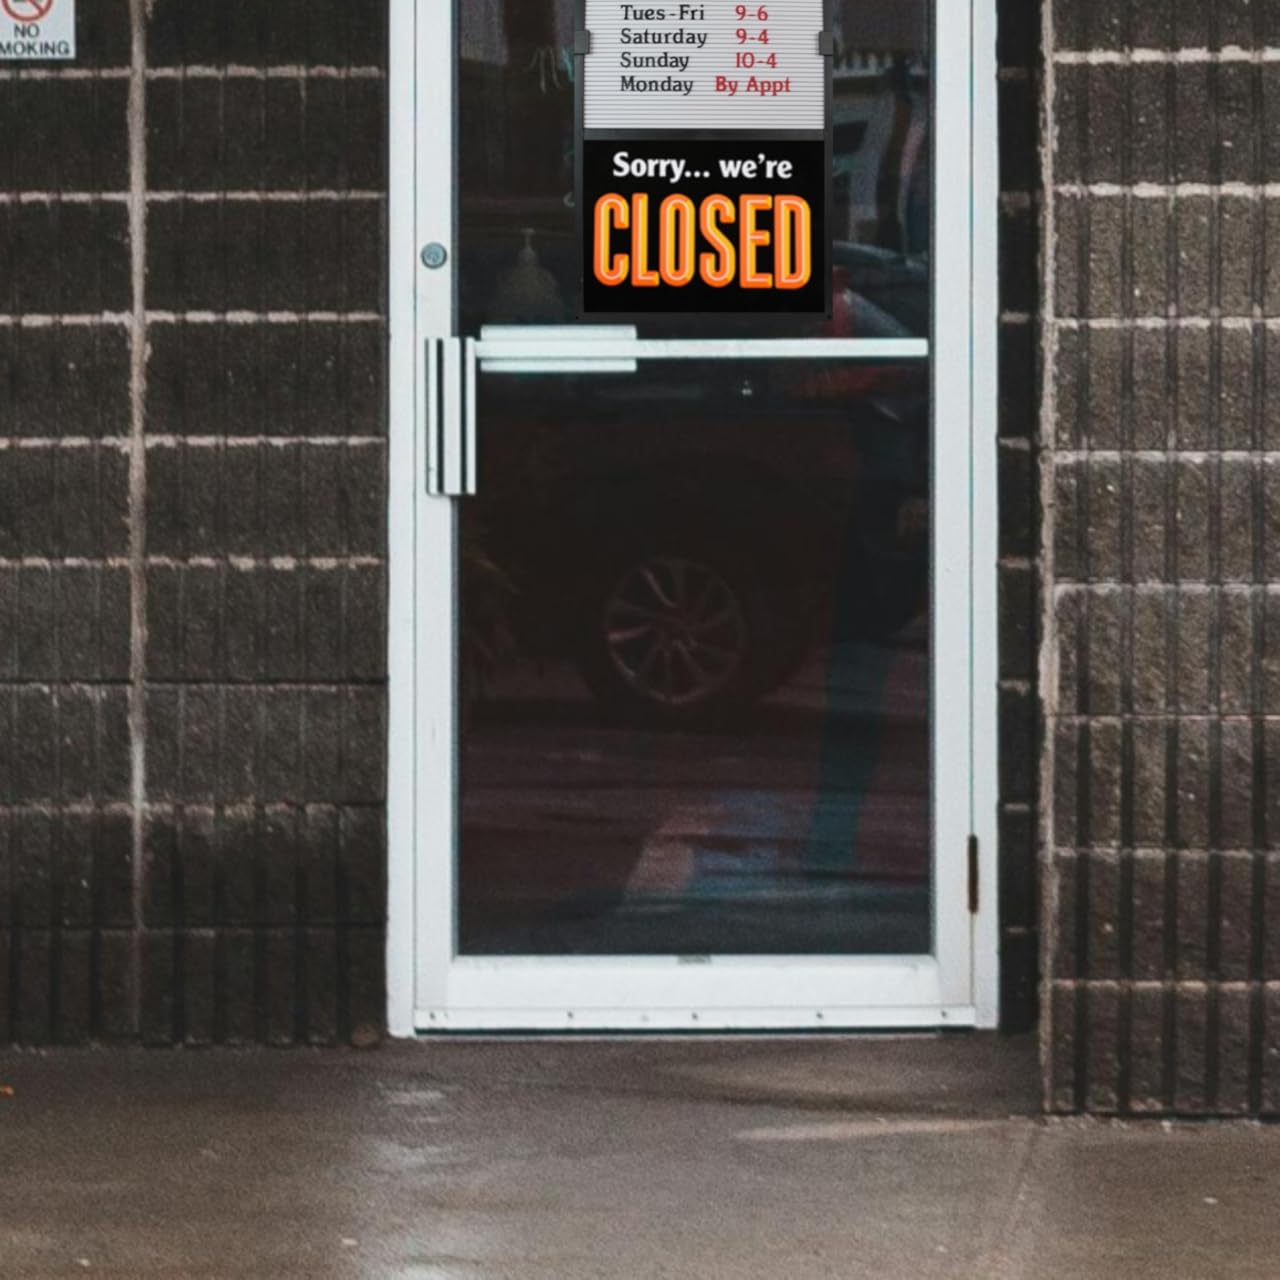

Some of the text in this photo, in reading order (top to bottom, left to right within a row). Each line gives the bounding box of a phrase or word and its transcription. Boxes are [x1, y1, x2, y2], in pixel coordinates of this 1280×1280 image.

[736, 5, 768, 21] 9-6
[14, 24, 39, 38] NO
[621, 28, 769, 48] Saturday 9-4
[621, 52, 777, 71] Sunday 10-4
[621, 76, 791, 96] Monday By Appt
[613, 152, 792, 183] Sorry... we're
[594, 193, 810, 290] CLOSED
